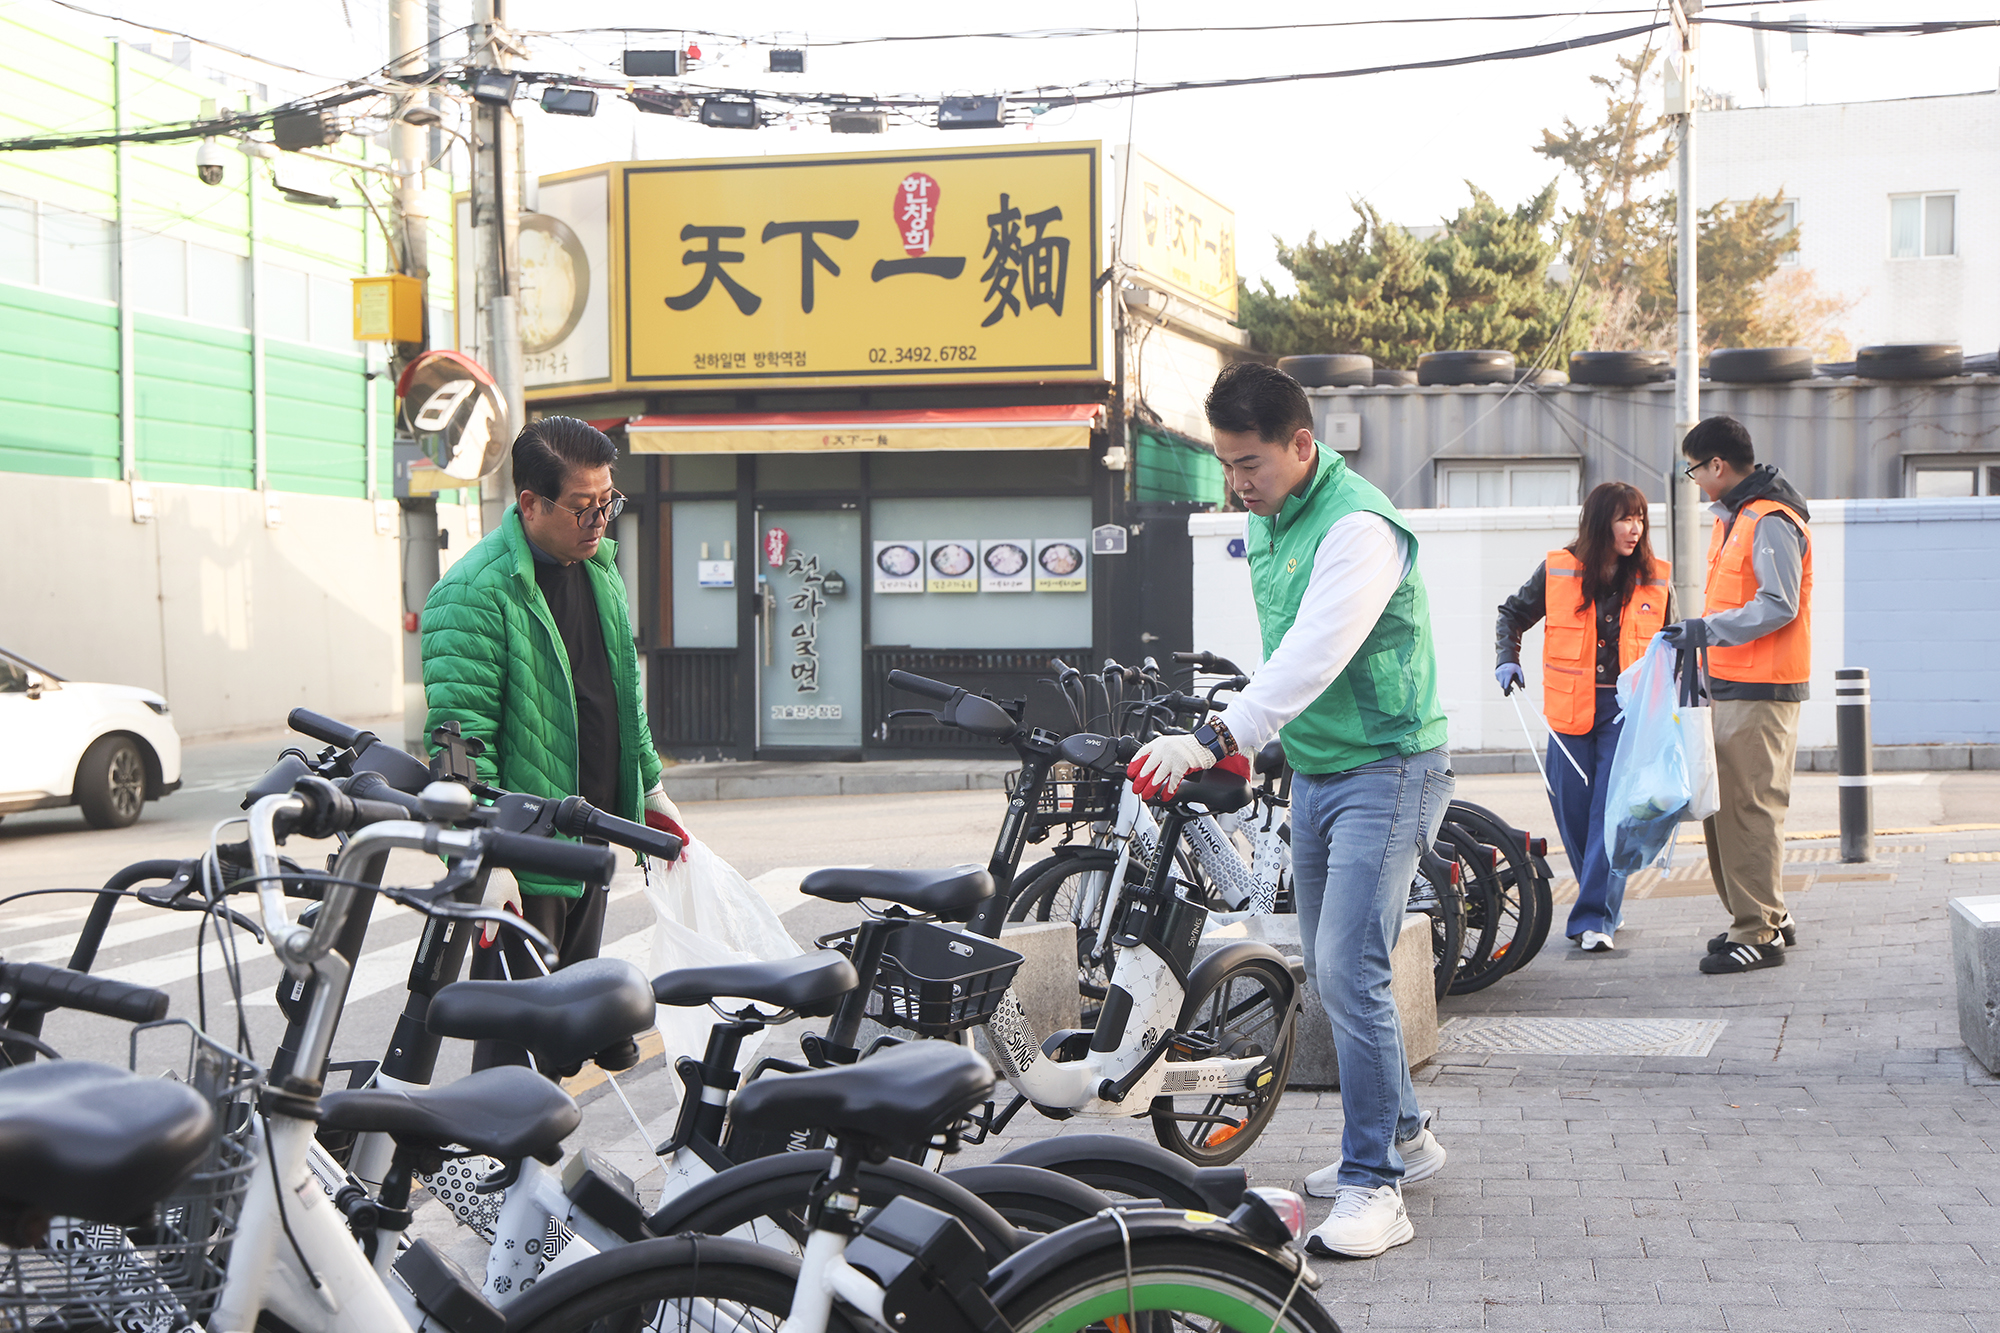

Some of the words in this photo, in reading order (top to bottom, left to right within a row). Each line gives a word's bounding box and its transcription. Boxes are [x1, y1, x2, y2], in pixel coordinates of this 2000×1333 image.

[902, 176, 932, 252] 한창희
[664, 193, 1071, 327] 天下一麵
[693, 352, 747, 369] 천하일면
[753, 350, 807, 368] 방학역점
[868, 345, 978, 366] 02.3492.6782
[1105, 538, 1114, 550] 9
[787, 551, 826, 693] 천하일면
[1181, 826, 1203, 858] WING
[1187, 917, 1203, 948] SWING
[1007, 1031, 1034, 1073] SWING
